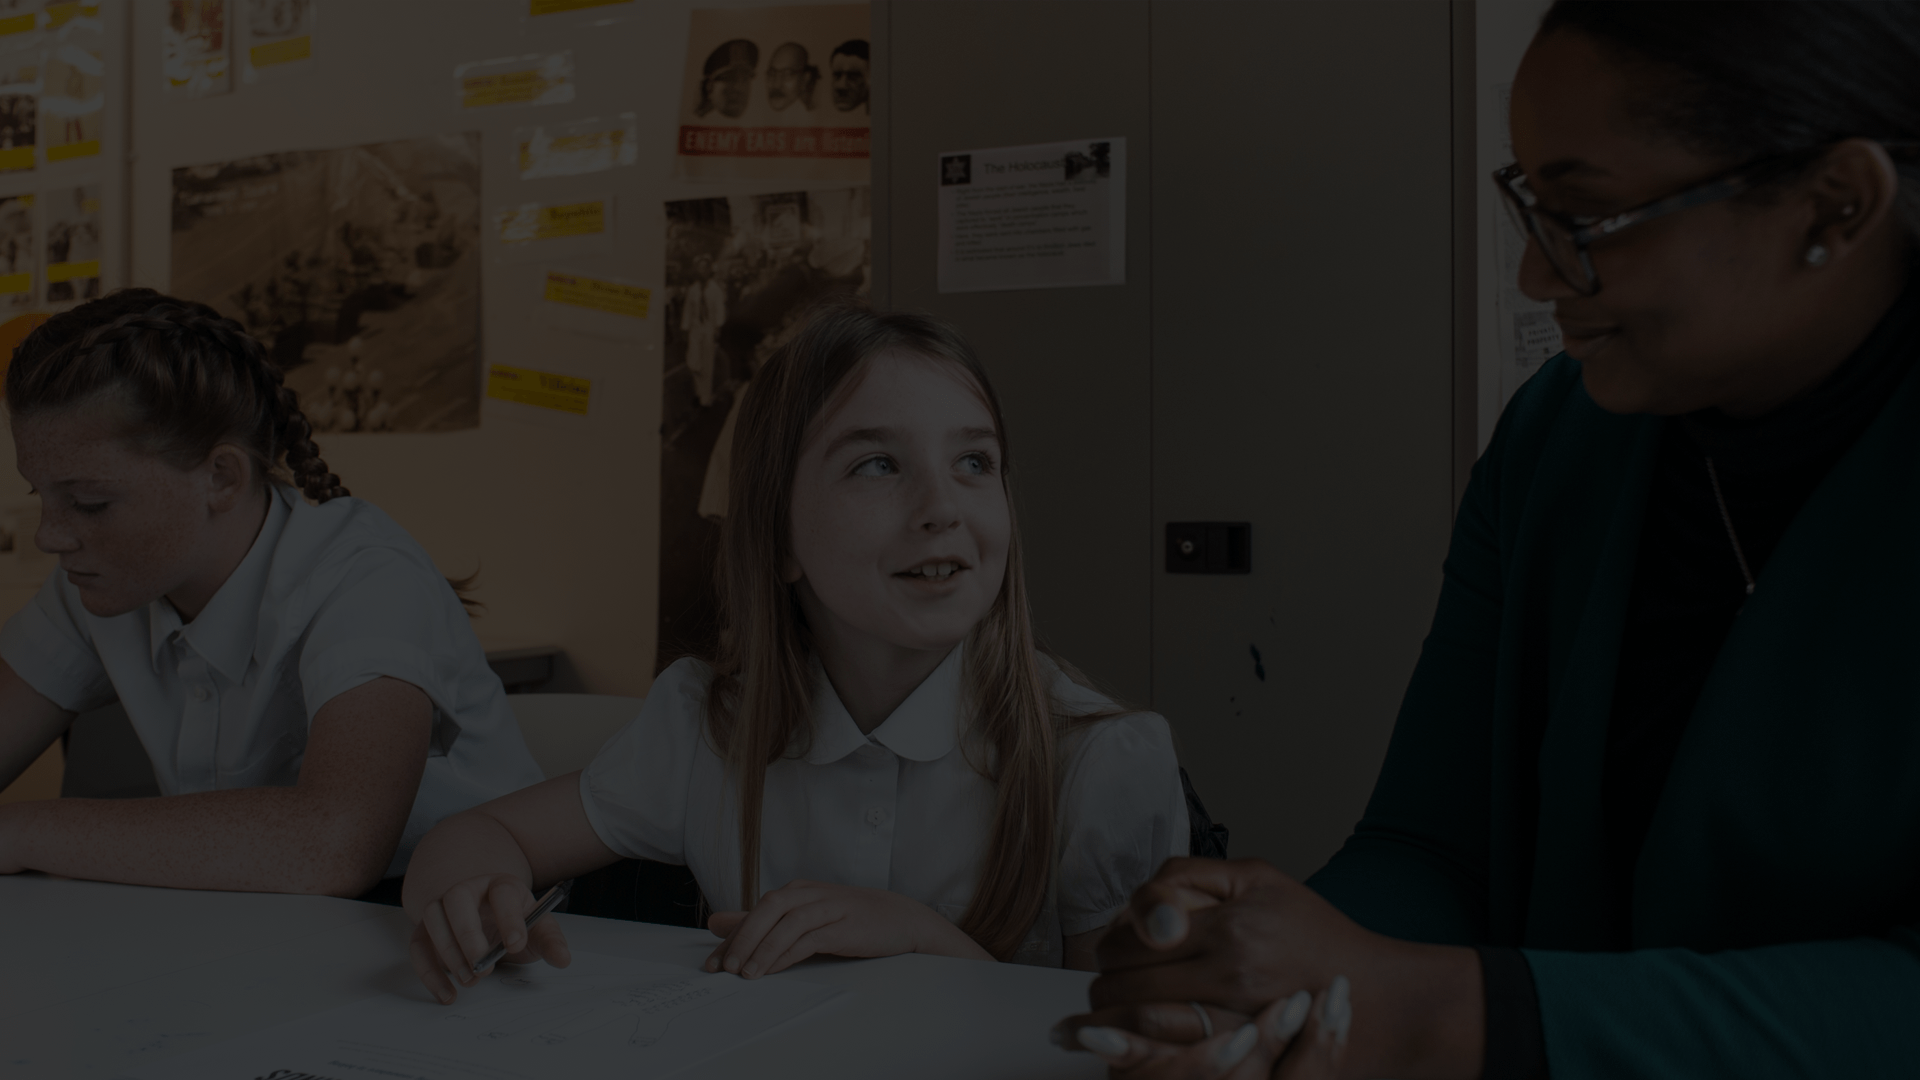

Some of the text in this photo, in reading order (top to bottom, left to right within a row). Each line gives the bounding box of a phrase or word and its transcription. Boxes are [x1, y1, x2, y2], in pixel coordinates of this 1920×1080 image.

[685, 130, 741, 151] ENEMY
[745, 131, 786, 152] EARS
[983, 162, 1005, 175] The
[1528, 325, 1555, 336] PRIVATE
[1526, 334, 1560, 345] PROPERTY
